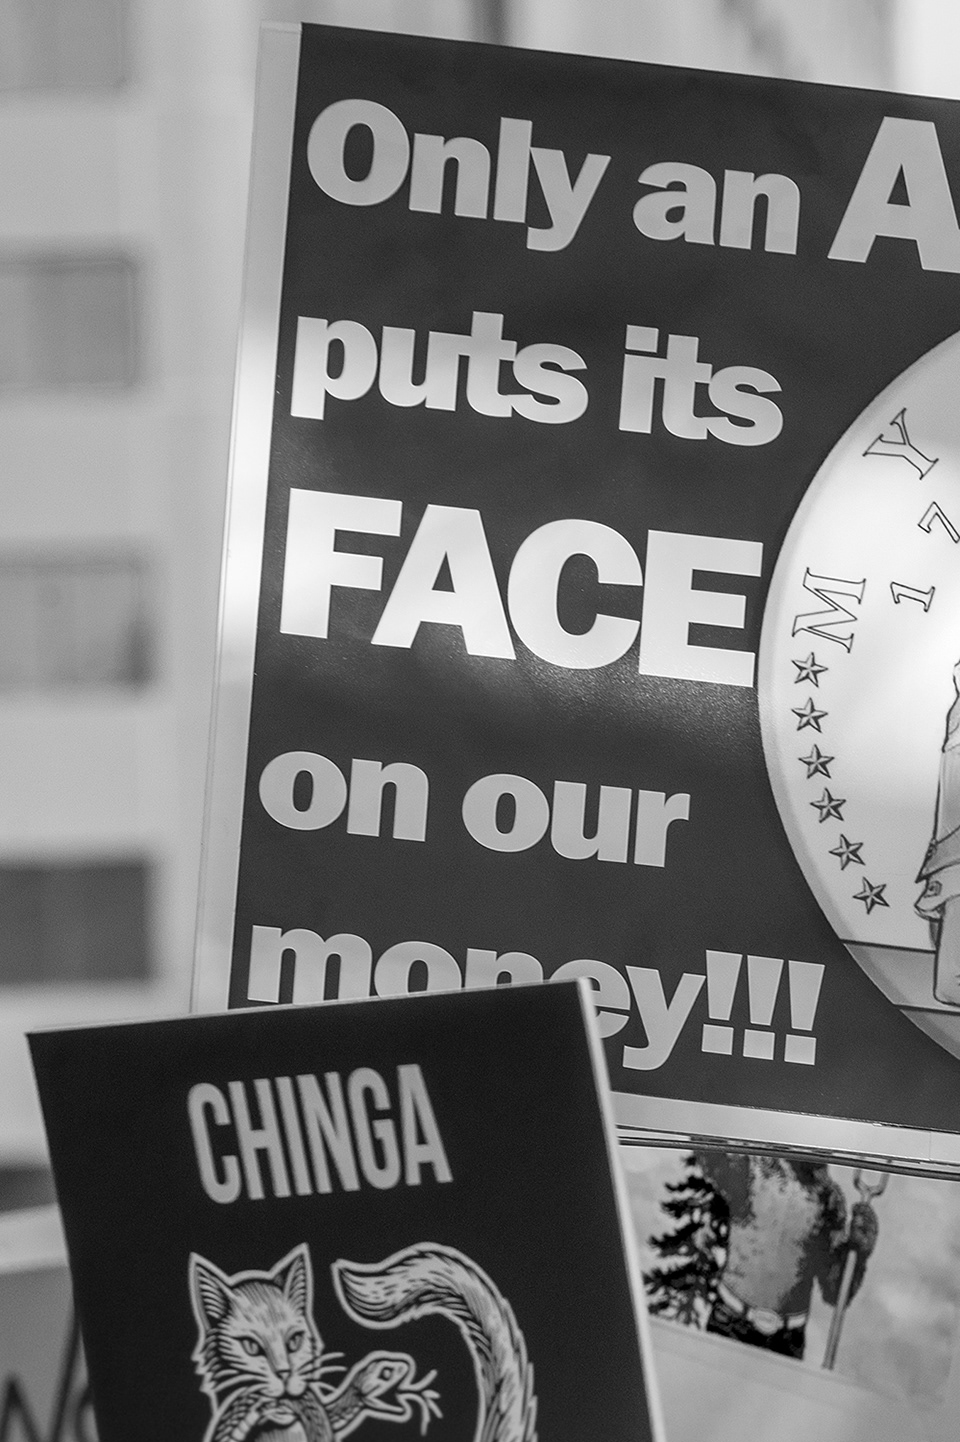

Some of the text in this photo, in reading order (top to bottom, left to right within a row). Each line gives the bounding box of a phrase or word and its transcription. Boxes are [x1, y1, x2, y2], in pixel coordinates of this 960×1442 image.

[307, 99, 611, 252] Only
[632, 161, 801, 255] an
[290, 311, 784, 446] puts its
[279, 487, 764, 688] FACE
[258, 750, 691, 868] on our
[187, 1063, 453, 1204] CHINGA
